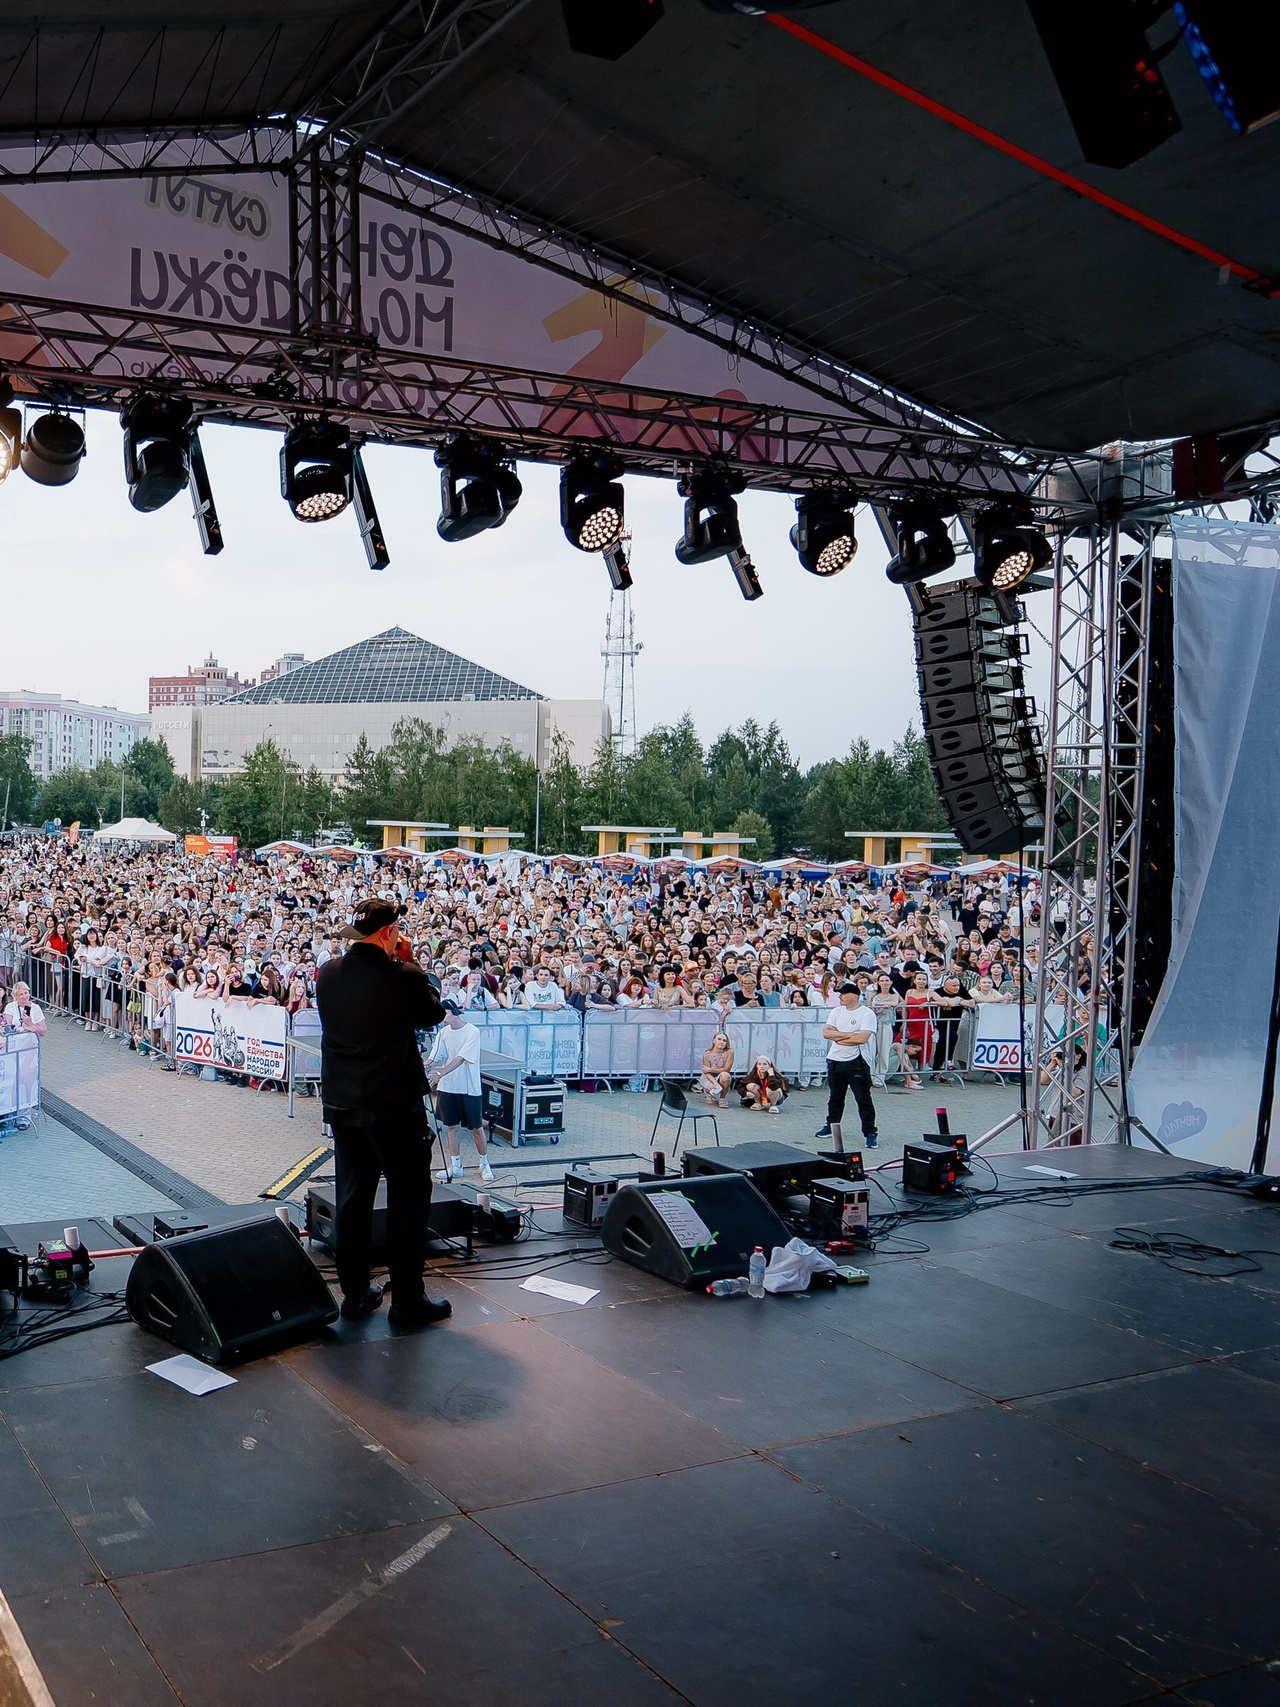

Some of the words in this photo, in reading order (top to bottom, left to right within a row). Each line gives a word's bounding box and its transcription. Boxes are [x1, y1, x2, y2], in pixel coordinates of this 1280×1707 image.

[176, 1032, 212, 1057] 2026
[247, 1037, 261, 1048] ГОД
[247, 1047, 284, 1060] ЕДИНСТВА
[974, 1044, 1020, 1065] 2026
[247, 1056, 280, 1068] НАРОДОВ
[247, 1064, 275, 1076] РОССИИ
